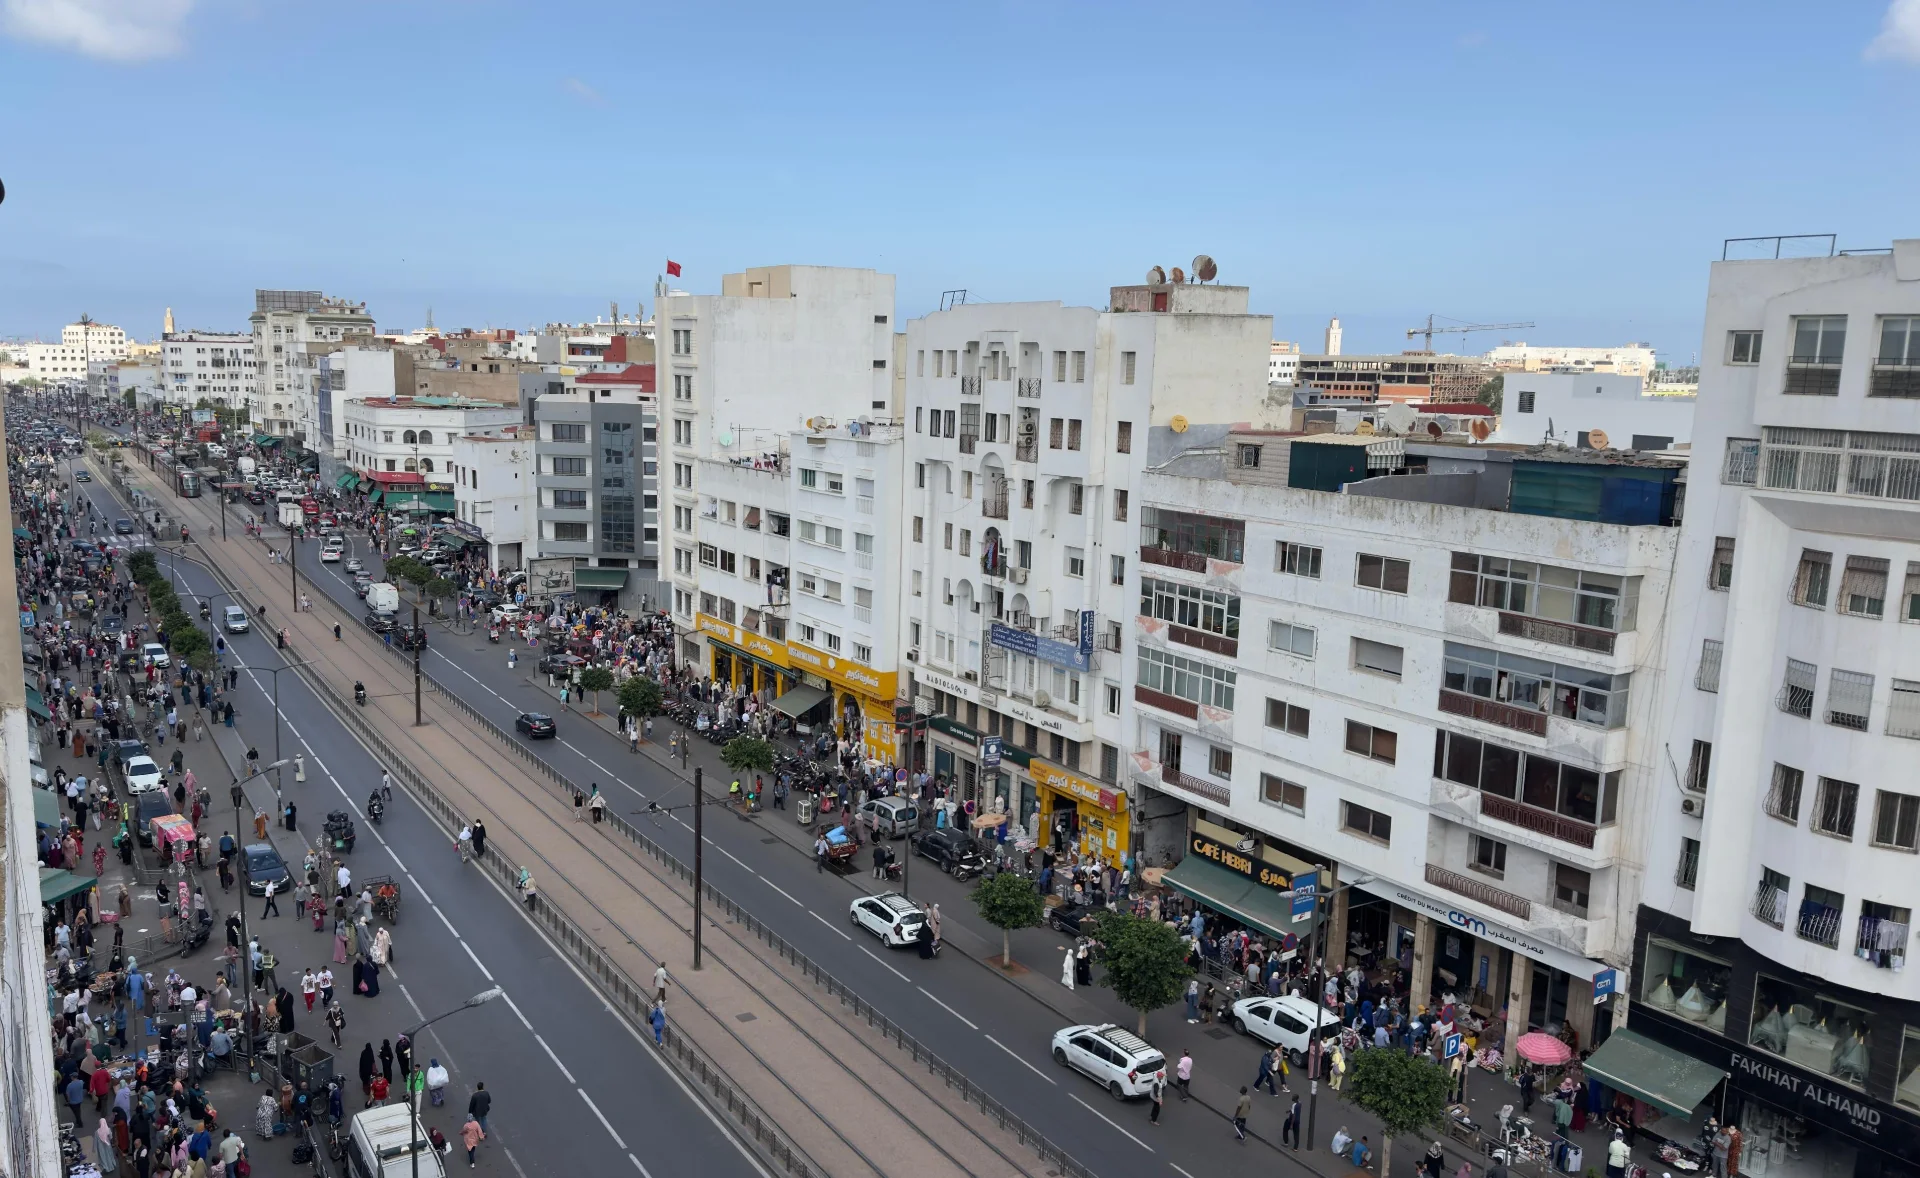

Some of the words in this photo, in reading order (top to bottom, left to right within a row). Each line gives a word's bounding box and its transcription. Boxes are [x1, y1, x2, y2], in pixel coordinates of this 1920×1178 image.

[1193, 839, 1220, 860] CAFÉ
[1221, 849, 1252, 875] HEBRI
[1259, 868, 1288, 888] هبري
[1417, 900, 1426, 908] DU
[1426, 904, 1447, 917] MAROC
[1487, 929, 1517, 944] المغرب
[1518, 940, 1544, 955] مصرف
[1449, 1039, 1457, 1053] P
[1730, 1053, 1802, 1094] FAKIHAT
[1803, 1083, 1881, 1126] ALHAMD
